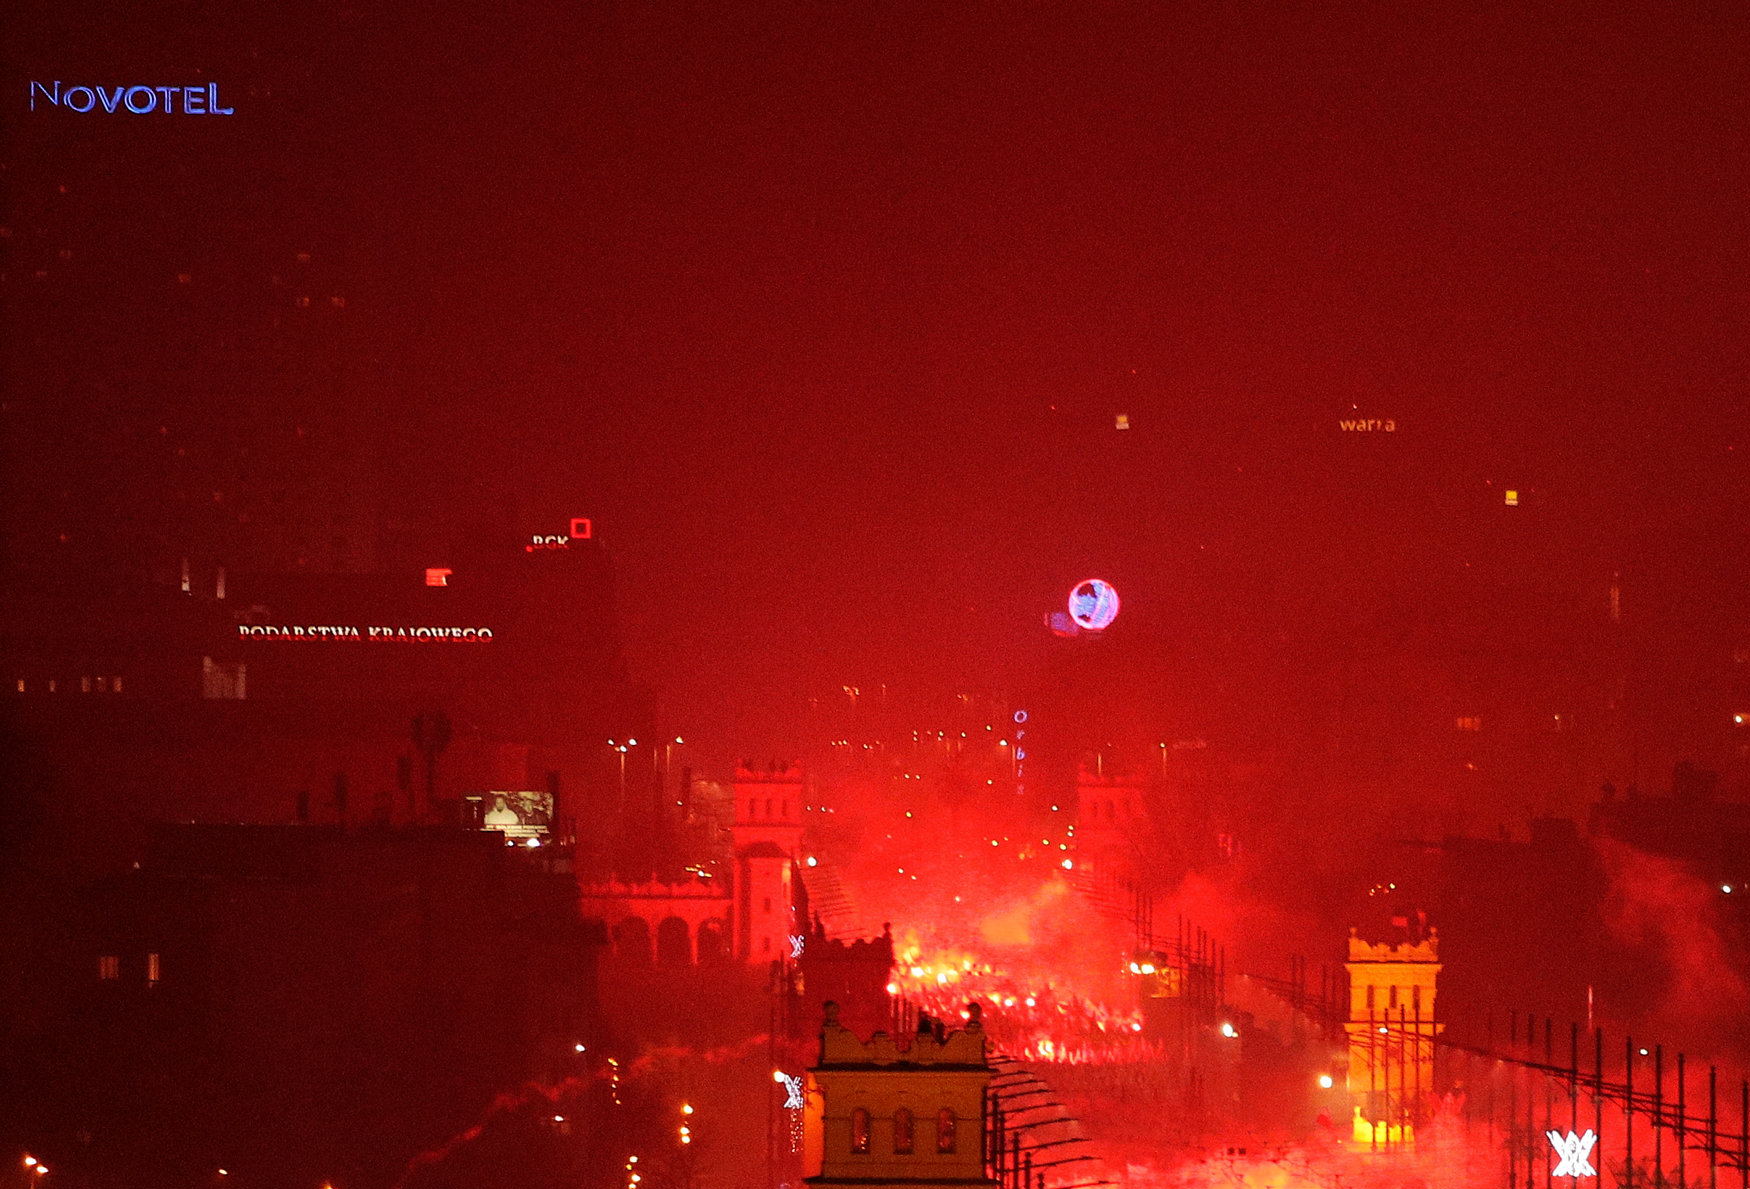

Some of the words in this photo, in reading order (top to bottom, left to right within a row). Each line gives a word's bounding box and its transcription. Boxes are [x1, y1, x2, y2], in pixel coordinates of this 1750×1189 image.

[29, 80, 235, 116] NOVOTEL
[367, 626, 494, 643] KRAJOWEGO
[1013, 709, 1028, 796] Orbis
